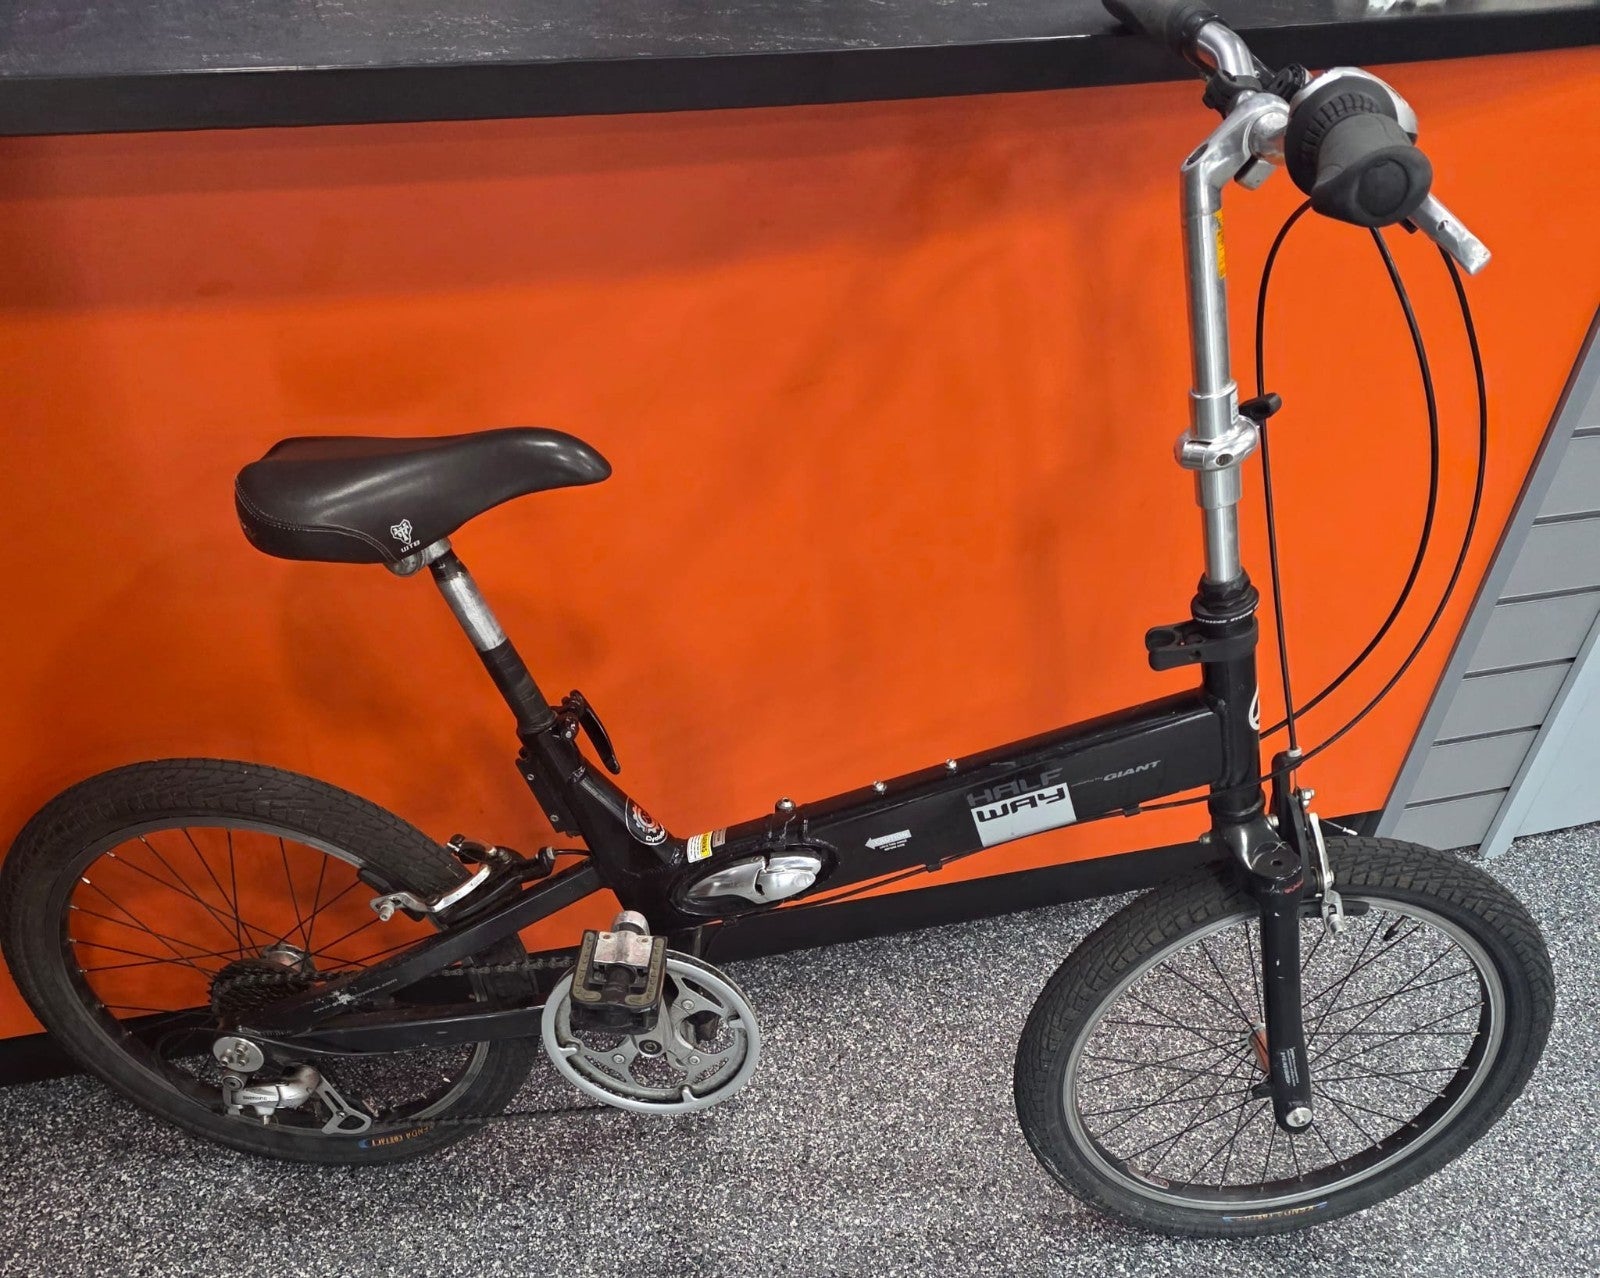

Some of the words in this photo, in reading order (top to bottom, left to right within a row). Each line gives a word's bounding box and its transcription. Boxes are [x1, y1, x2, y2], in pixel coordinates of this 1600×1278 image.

[966, 767, 1063, 807] HALF
[1103, 760, 1161, 782] GIANT
[976, 786, 1066, 823] WAY
